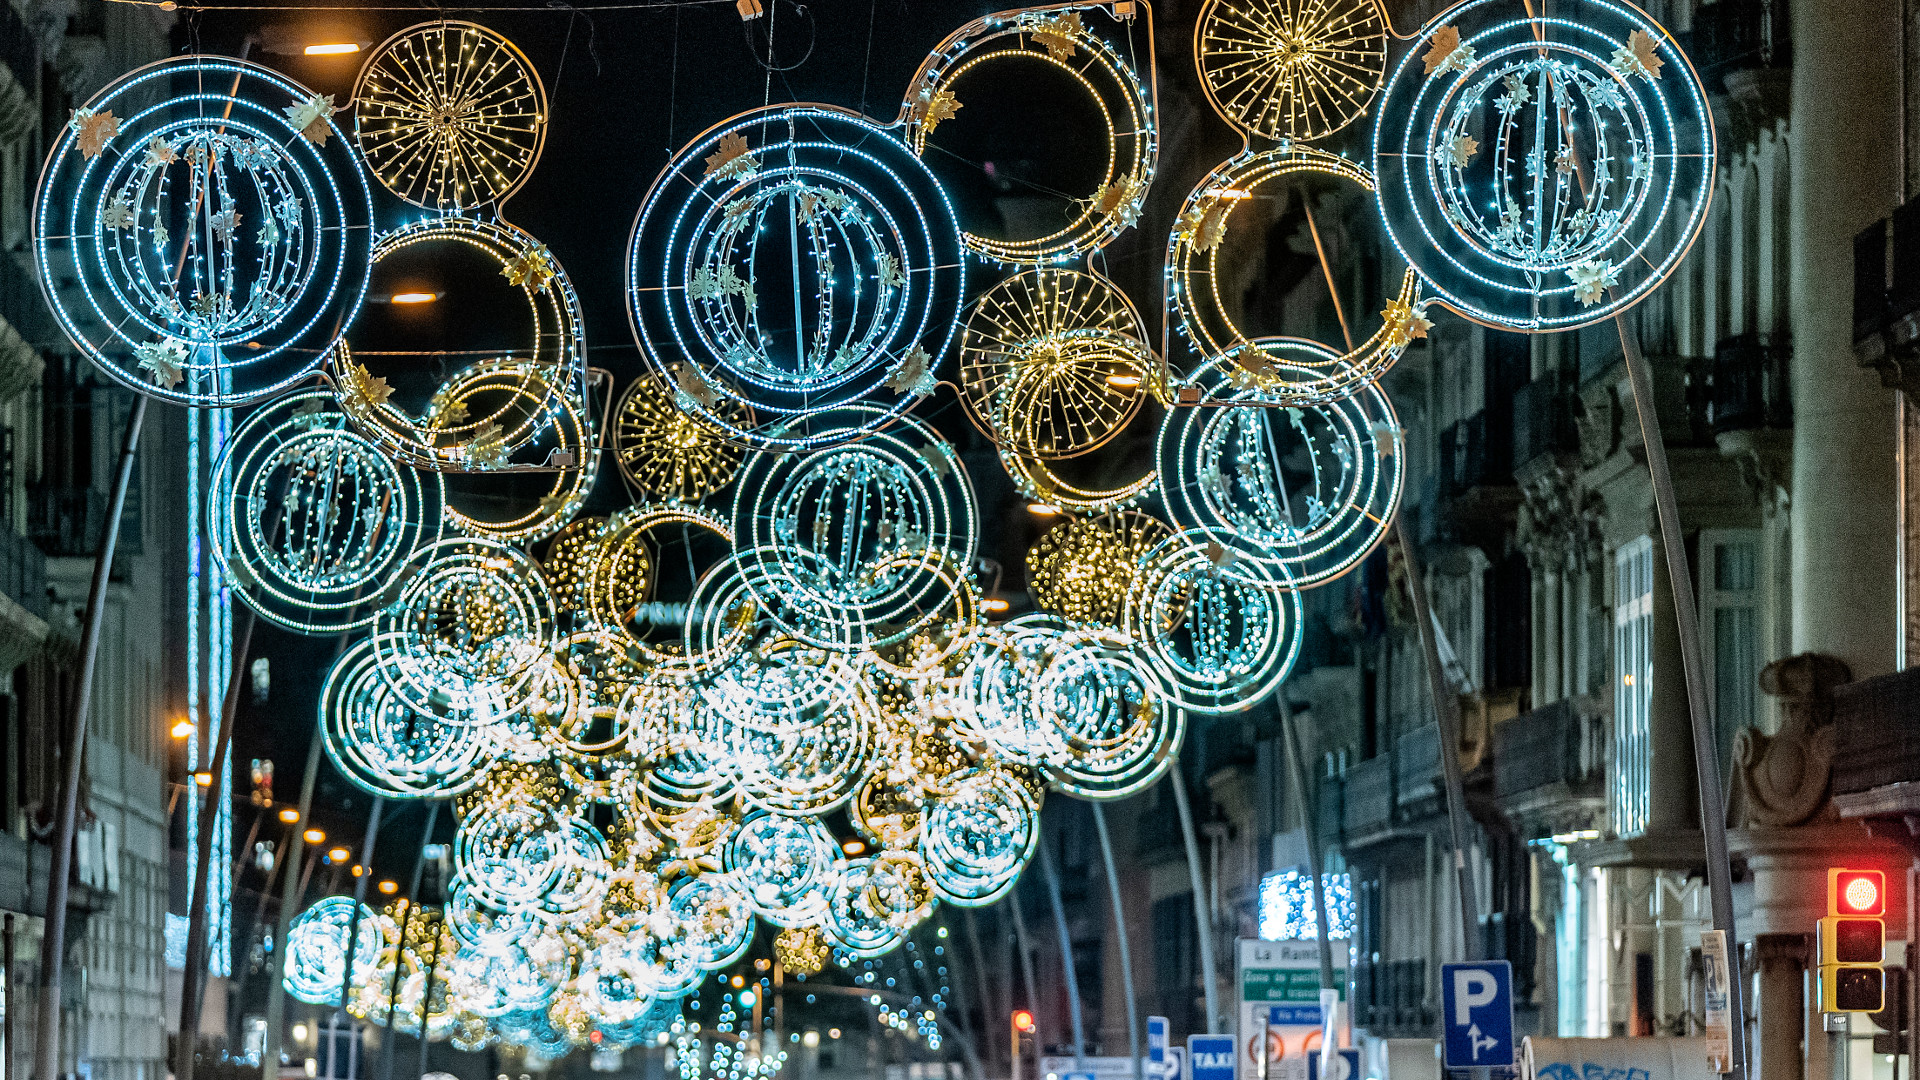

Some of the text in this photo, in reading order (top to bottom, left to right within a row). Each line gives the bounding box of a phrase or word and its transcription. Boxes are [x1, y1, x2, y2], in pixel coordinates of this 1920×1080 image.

[1254, 946, 1271, 960] La
[1454, 969, 1498, 1026] P
[1194, 1052, 1233, 1069] TAXI
